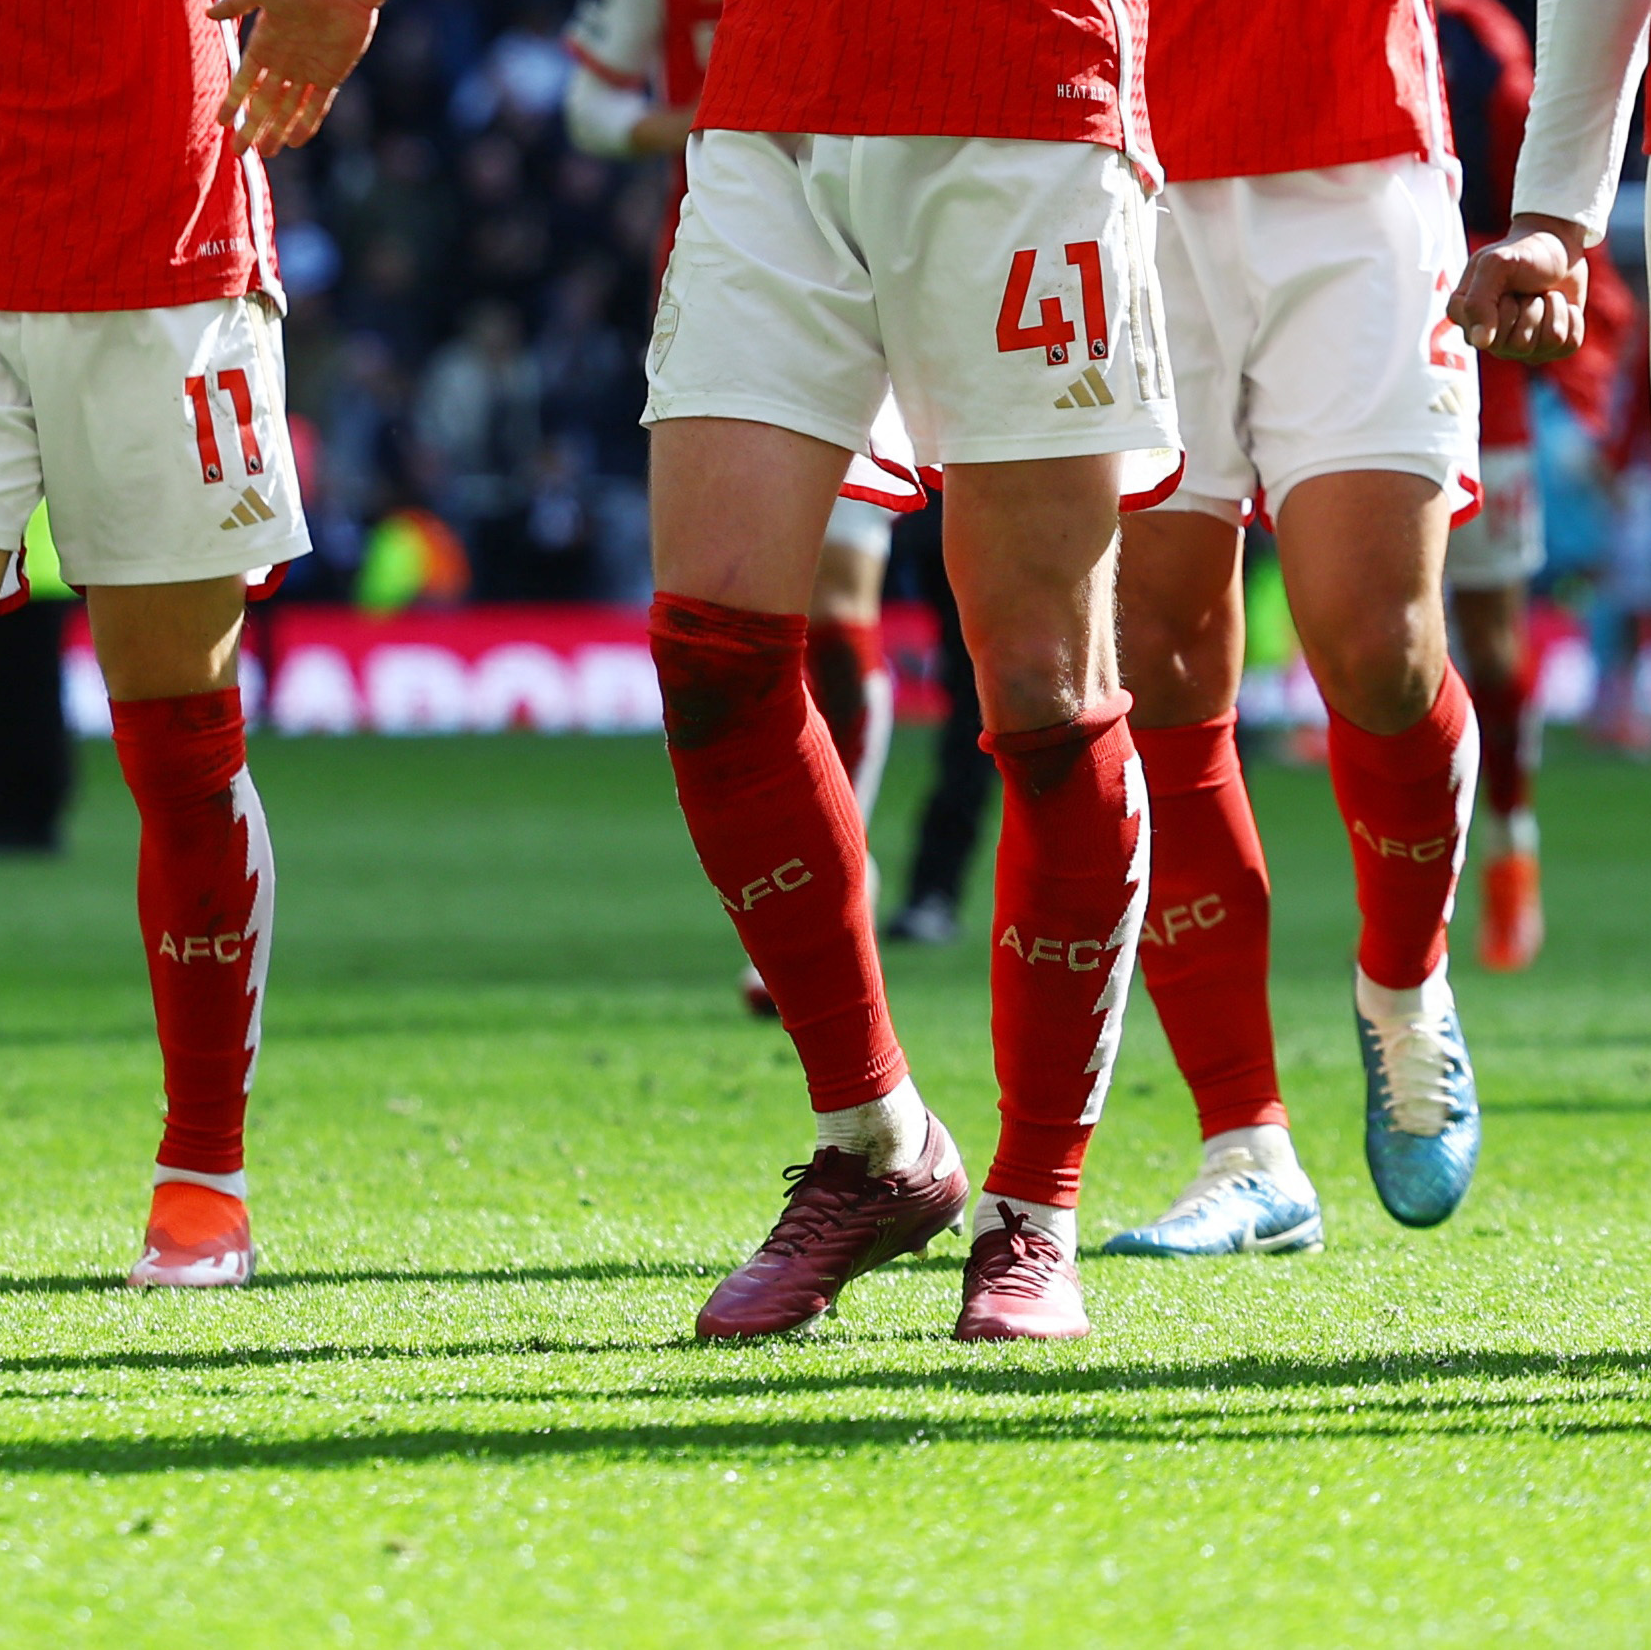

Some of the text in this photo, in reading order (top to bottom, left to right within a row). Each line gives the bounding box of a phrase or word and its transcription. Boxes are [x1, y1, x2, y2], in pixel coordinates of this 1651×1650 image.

[995, 240, 1109, 366] 41
[184, 368, 264, 484] 11
[1353, 820, 1446, 862] AFC
[1140, 893, 1227, 947] AFC
[159, 931, 242, 964] AFC
[999, 924, 1102, 972] AFC
